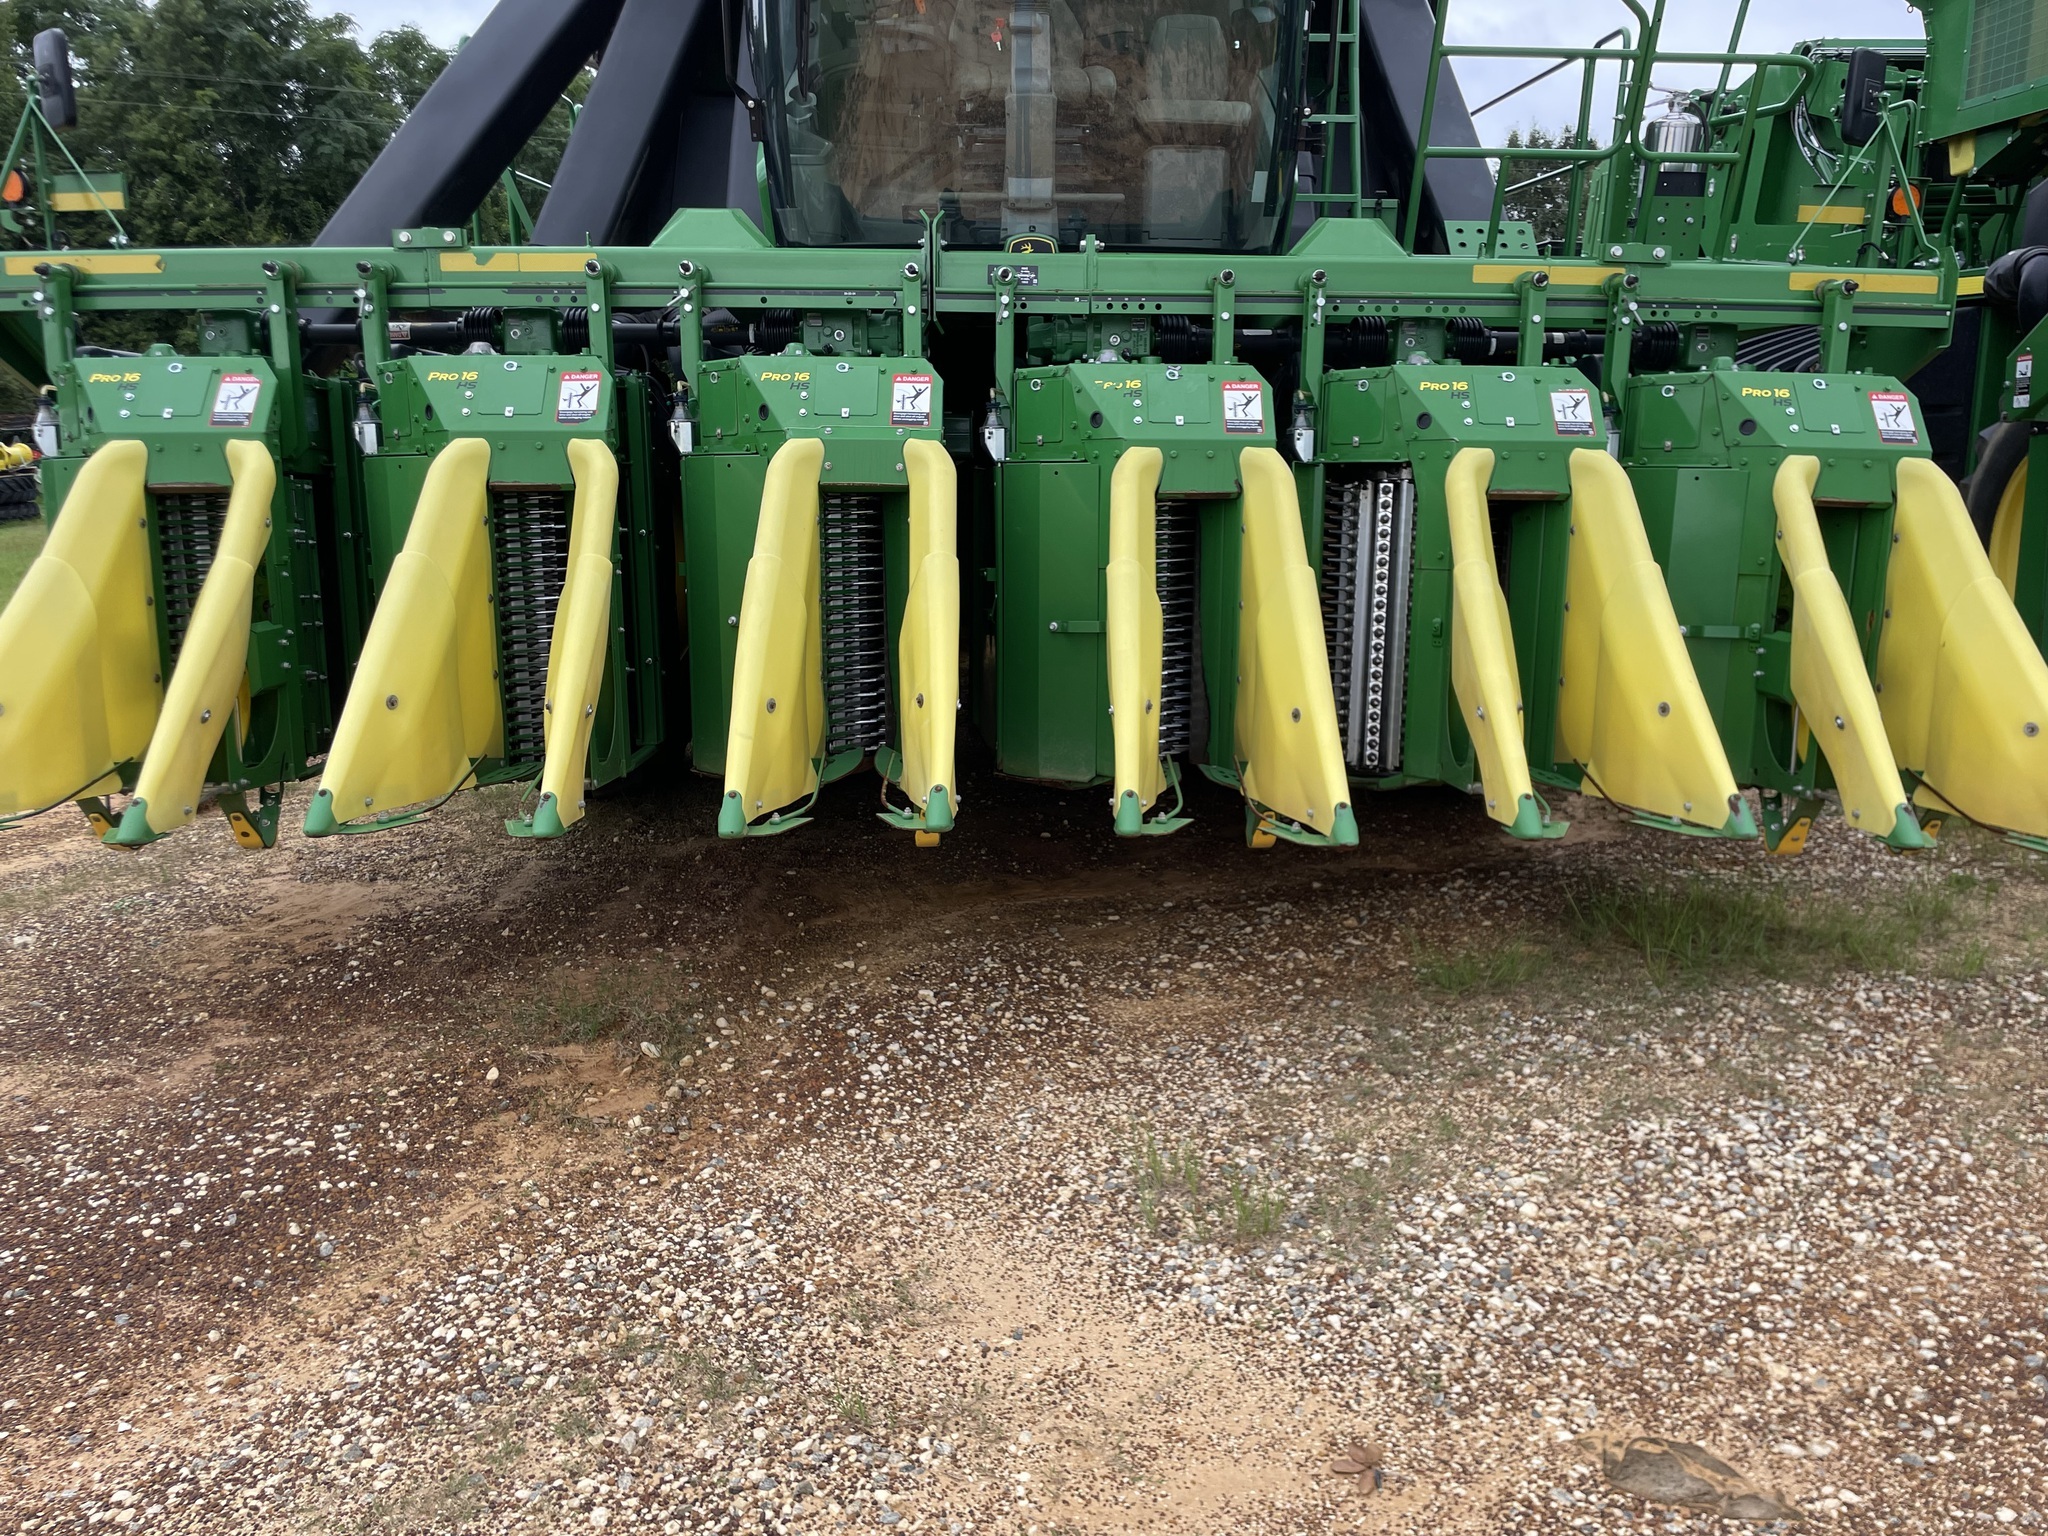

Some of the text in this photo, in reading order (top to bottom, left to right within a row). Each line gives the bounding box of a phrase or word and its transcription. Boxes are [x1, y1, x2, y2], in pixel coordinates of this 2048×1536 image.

[122, 372, 141, 383] 16
[461, 371, 479, 381] 16
[793, 372, 811, 381] 16
[117, 383, 139, 391] HS
[456, 381, 478, 389] HS
[789, 382, 810, 390] HS
[1125, 379, 1142, 389] 16
[1451, 381, 1469, 391] 16
[1450, 391, 1470, 399] HS
[1773, 388, 1791, 398] 16
[1773, 399, 1792, 407] HS
